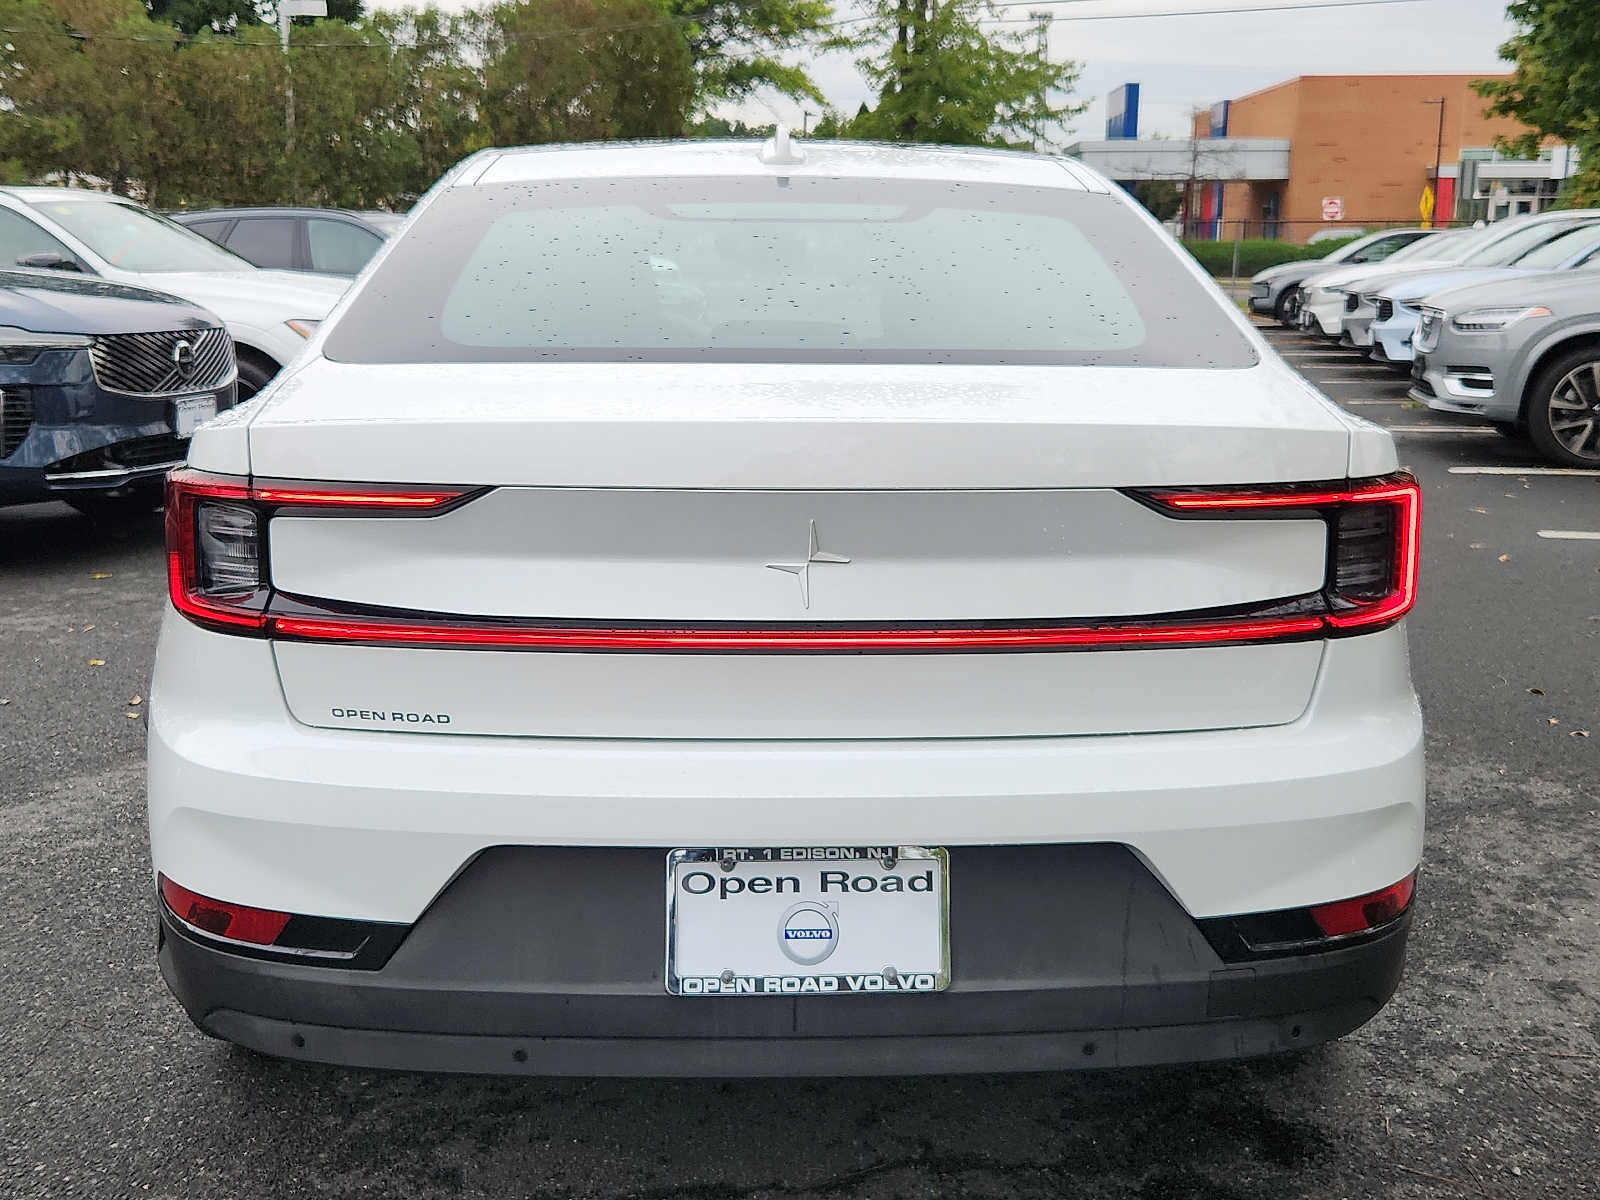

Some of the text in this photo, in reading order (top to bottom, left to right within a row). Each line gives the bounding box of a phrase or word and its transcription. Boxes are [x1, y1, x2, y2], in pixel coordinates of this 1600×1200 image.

[331, 708, 451, 724] OPEN ROAD
[722, 849, 755, 861] RT.
[763, 849, 772, 860] 1
[867, 847, 893, 860] NJ
[681, 870, 934, 900] Open Road
[786, 930, 831, 938] VOLVO
[683, 974, 936, 993] OPEN ROAD VOLVO
